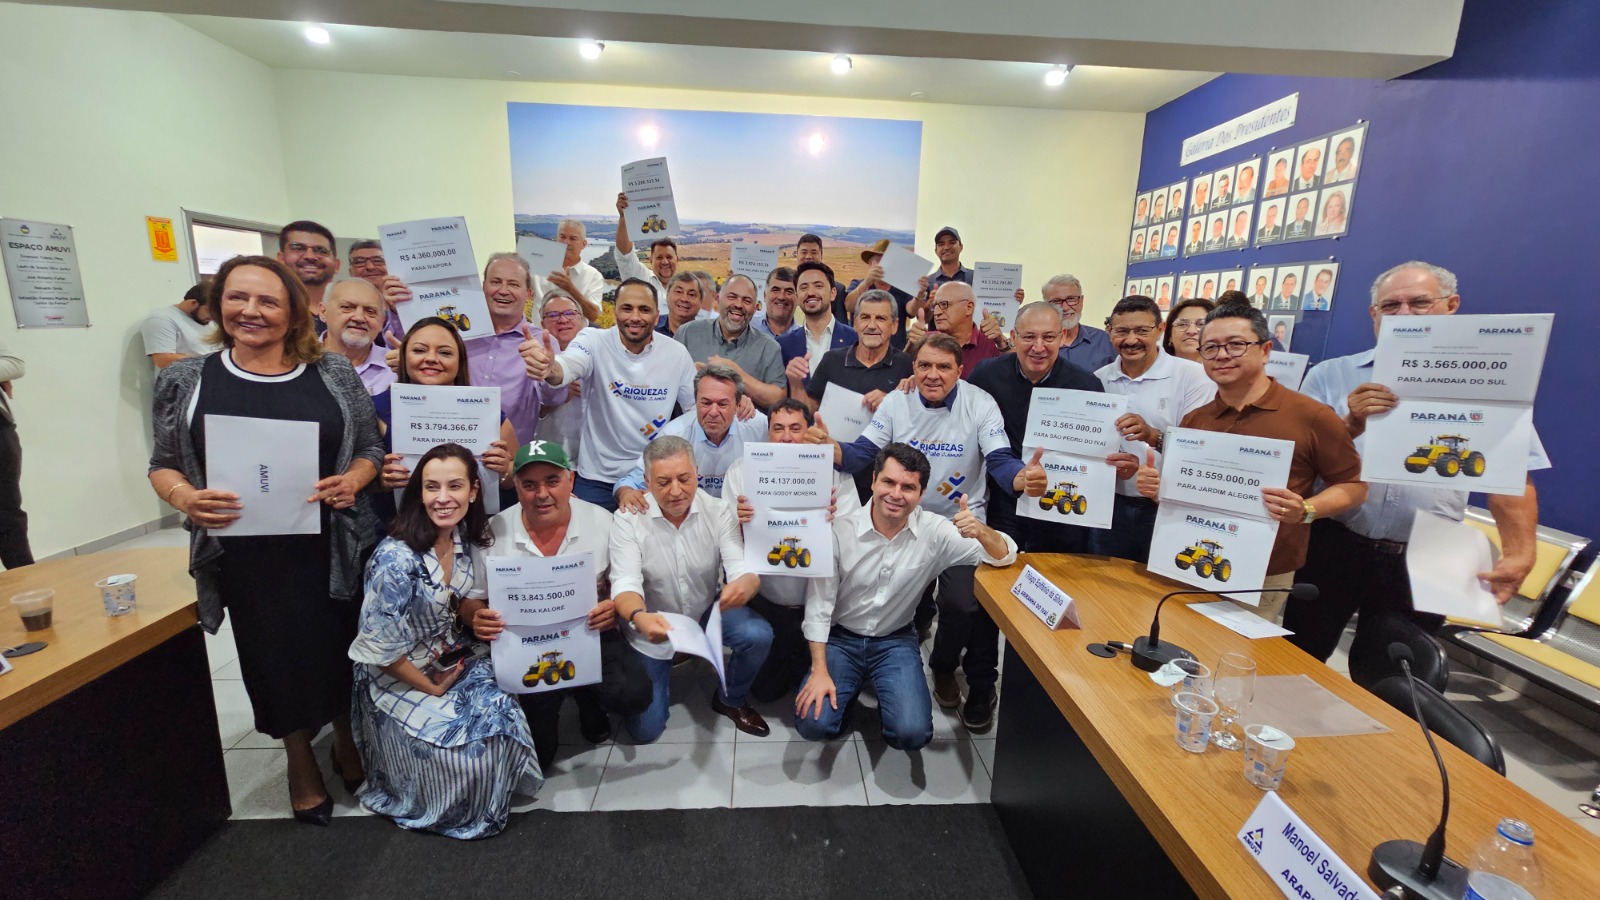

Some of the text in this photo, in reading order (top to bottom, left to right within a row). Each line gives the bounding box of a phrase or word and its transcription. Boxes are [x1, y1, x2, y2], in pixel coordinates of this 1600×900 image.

[1234, 106, 1292, 140] Presidentes
[8, 241, 71, 253] ESPAÇO AMUVI
[412, 248, 456, 260] 4.360.000,00
[1402, 360, 1507, 370] R$ 3.565.000,00
[624, 387, 668, 396] RIQUEZAS
[1410, 412, 1467, 421] PARANÁ
[1053, 421, 1102, 434] 3.565.000,00
[528, 440, 547, 456] K
[920, 444, 964, 452] RIQUEZAS
[1045, 463, 1078, 472] PARANÁ
[259, 464, 269, 493] AMUVI
[1180, 467, 1260, 487] R$ 3.559.000,00
[1177, 482, 1259, 502] PARA JARDIM ALEGRE
[522, 589, 575, 601] 3.843.500,00
[539, 604, 565, 612] KALORÉ
[1243, 835, 1261, 855] AMUVI
[1282, 822, 1320, 866] Manoel
[1281, 869, 1315, 900] ARAP
